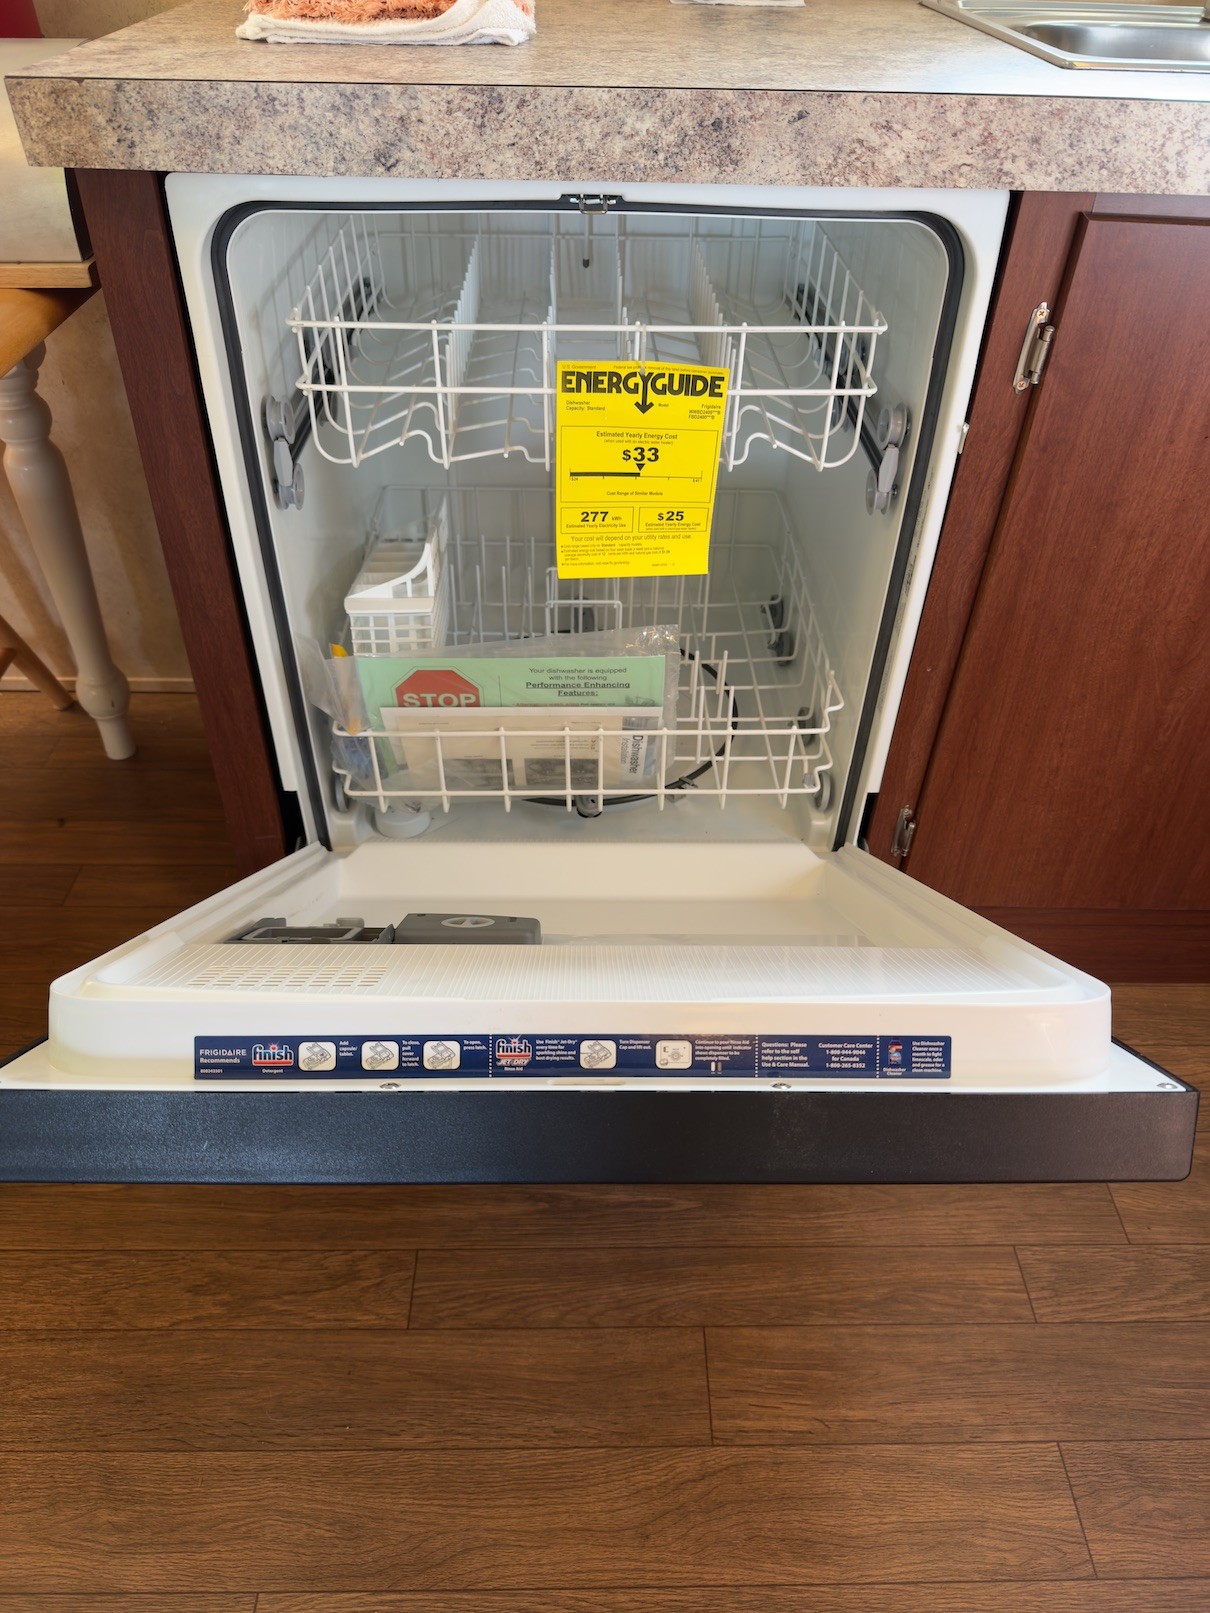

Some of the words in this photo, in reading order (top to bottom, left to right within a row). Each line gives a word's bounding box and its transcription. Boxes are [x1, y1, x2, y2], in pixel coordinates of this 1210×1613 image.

[562, 370, 724, 398] ENERGYGUIDE
[622, 447, 659, 462] $33
[581, 512, 609, 522] 277
[658, 511, 684, 521] $25
[403, 693, 476, 707] STOP
[629, 736, 643, 774] Dishwasher
[252, 1044, 294, 1060] finish
[496, 1039, 532, 1053] finish
